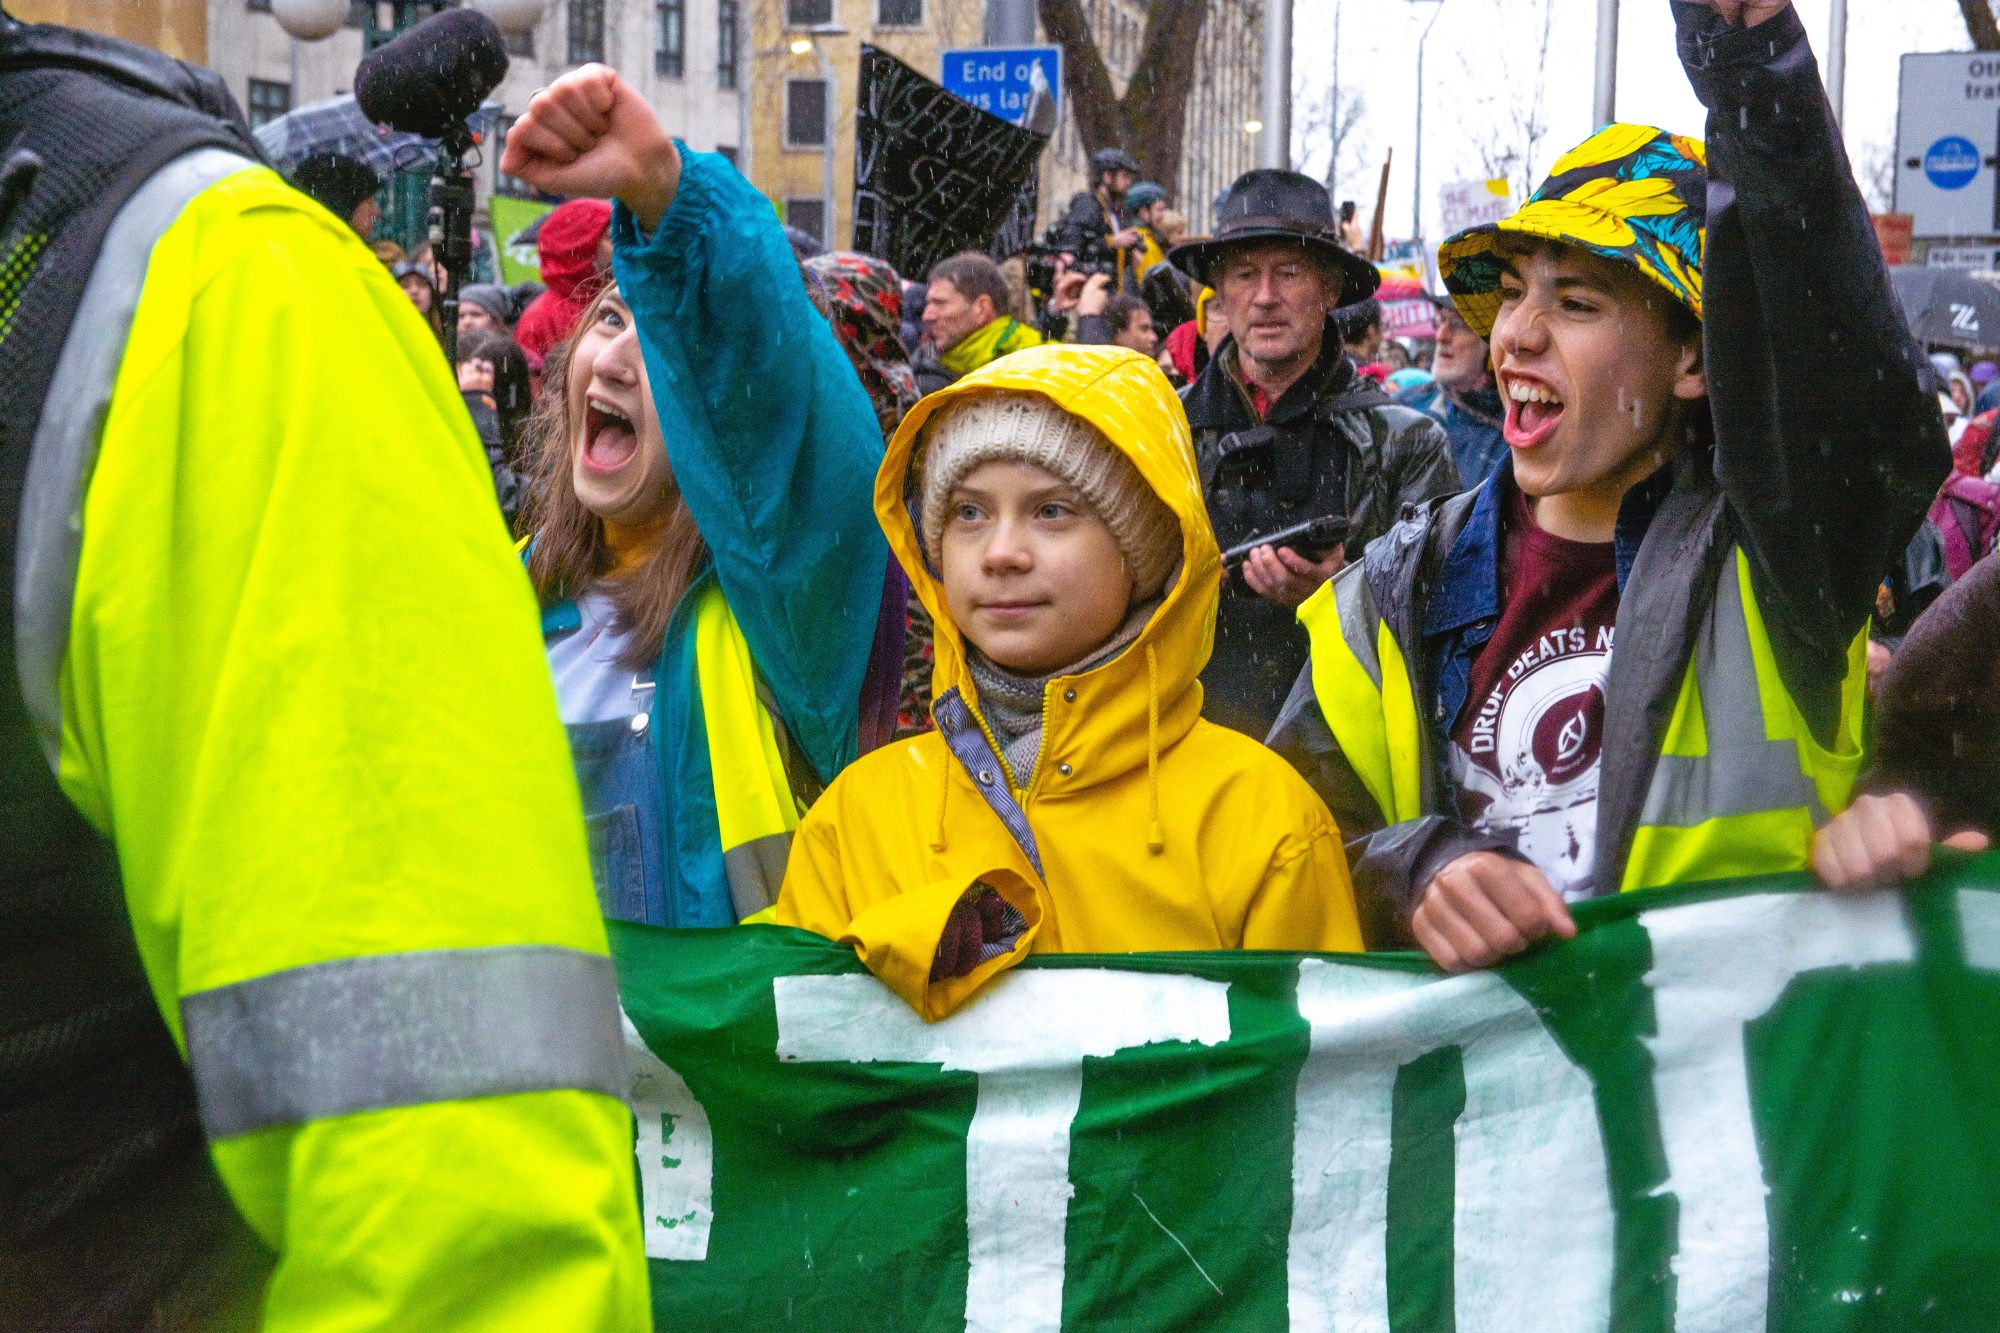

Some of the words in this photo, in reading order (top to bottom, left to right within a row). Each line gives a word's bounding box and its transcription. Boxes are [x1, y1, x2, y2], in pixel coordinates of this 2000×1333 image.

[962, 61, 1006, 82] End
[1965, 81, 2000, 99] tra
[1595, 625, 1615, 650] N
